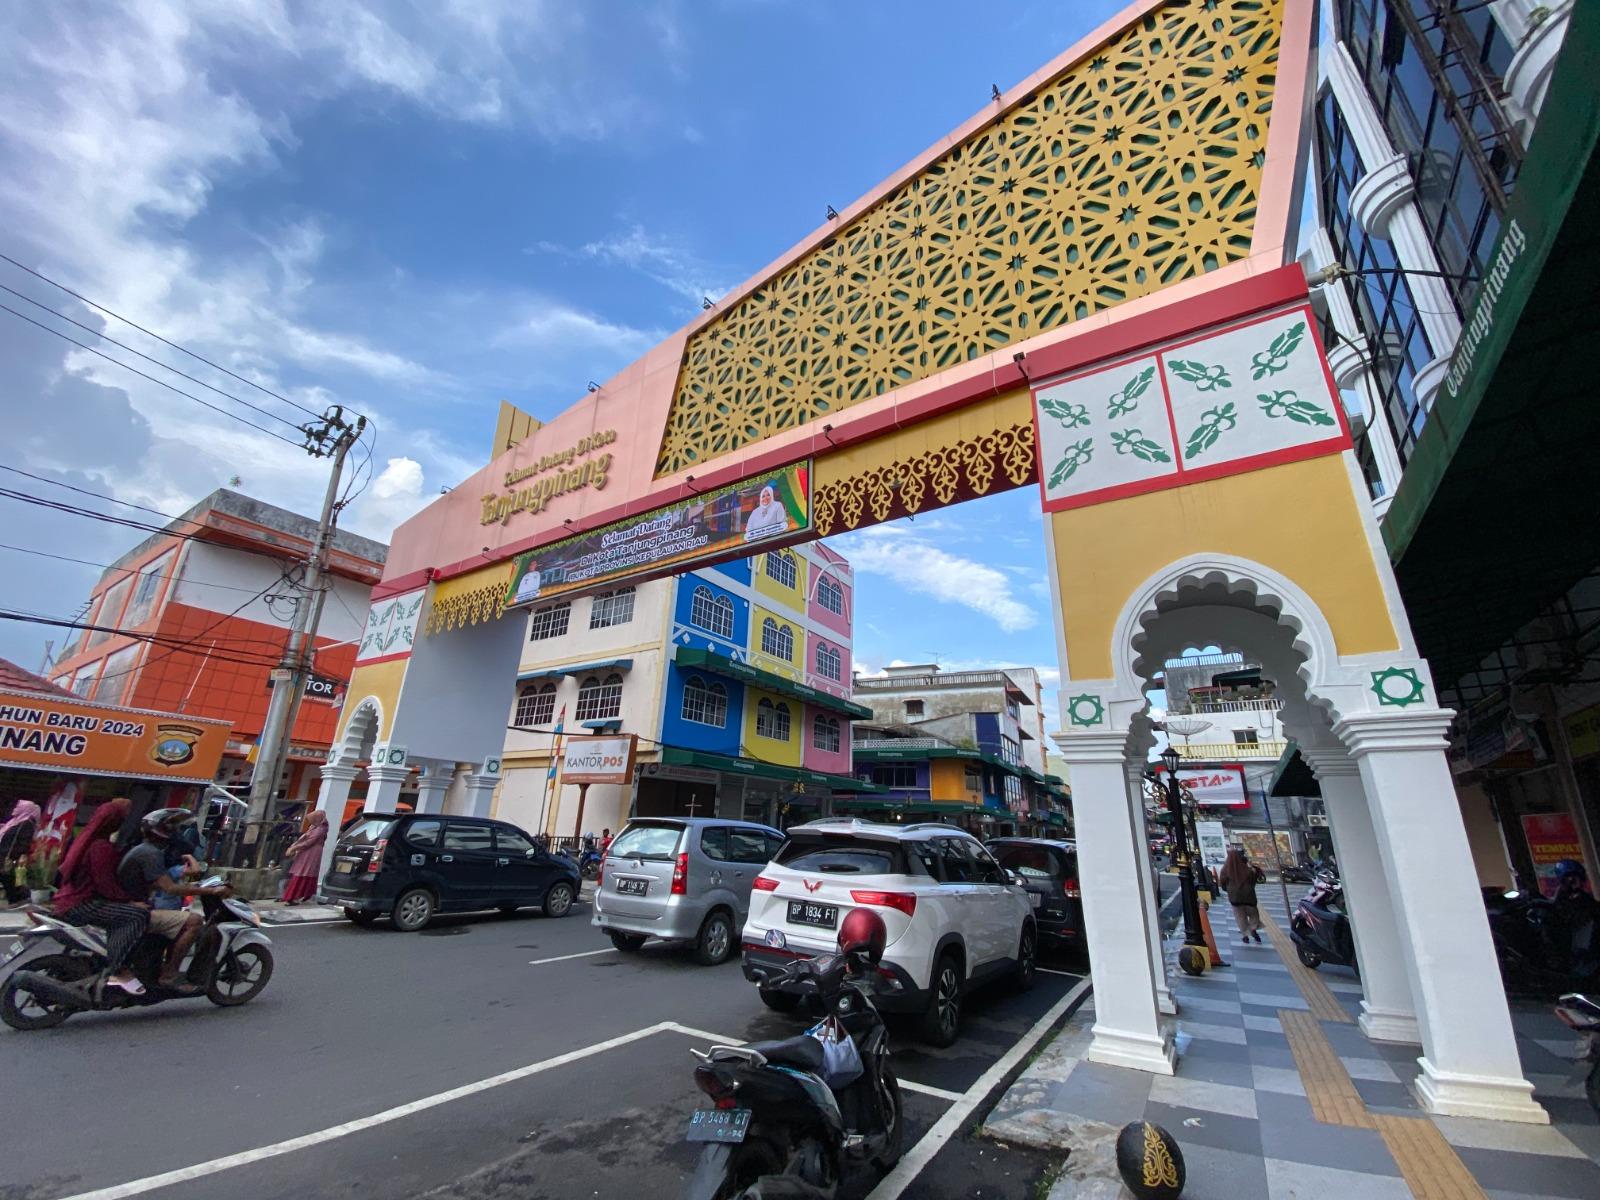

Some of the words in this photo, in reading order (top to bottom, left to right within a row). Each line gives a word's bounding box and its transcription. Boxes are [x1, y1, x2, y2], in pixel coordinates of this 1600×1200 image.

[480, 453, 613, 526] Tanjungpinang
[592, 547, 616, 563] Kota
[616, 525, 695, 557] Tanjungpinang
[601, 526, 638, 548] Selamat
[639, 516, 672, 535] Datang
[580, 563, 600, 578] KOTA
[600, 555, 636, 572] PROVINSI
[635, 541, 685, 564] KEPULAUAN
[685, 535, 708, 549] RIAU
[306, 680, 332, 694] TOR
[0, 706, 42, 724] HUN
[46, 713, 98, 731] BARU
[101, 720, 144, 737] 2024
[792, 904, 802, 915] BP
[805, 905, 822, 919] 1834
[825, 908, 836, 920] FT
[692, 1111, 706, 1124] BP
